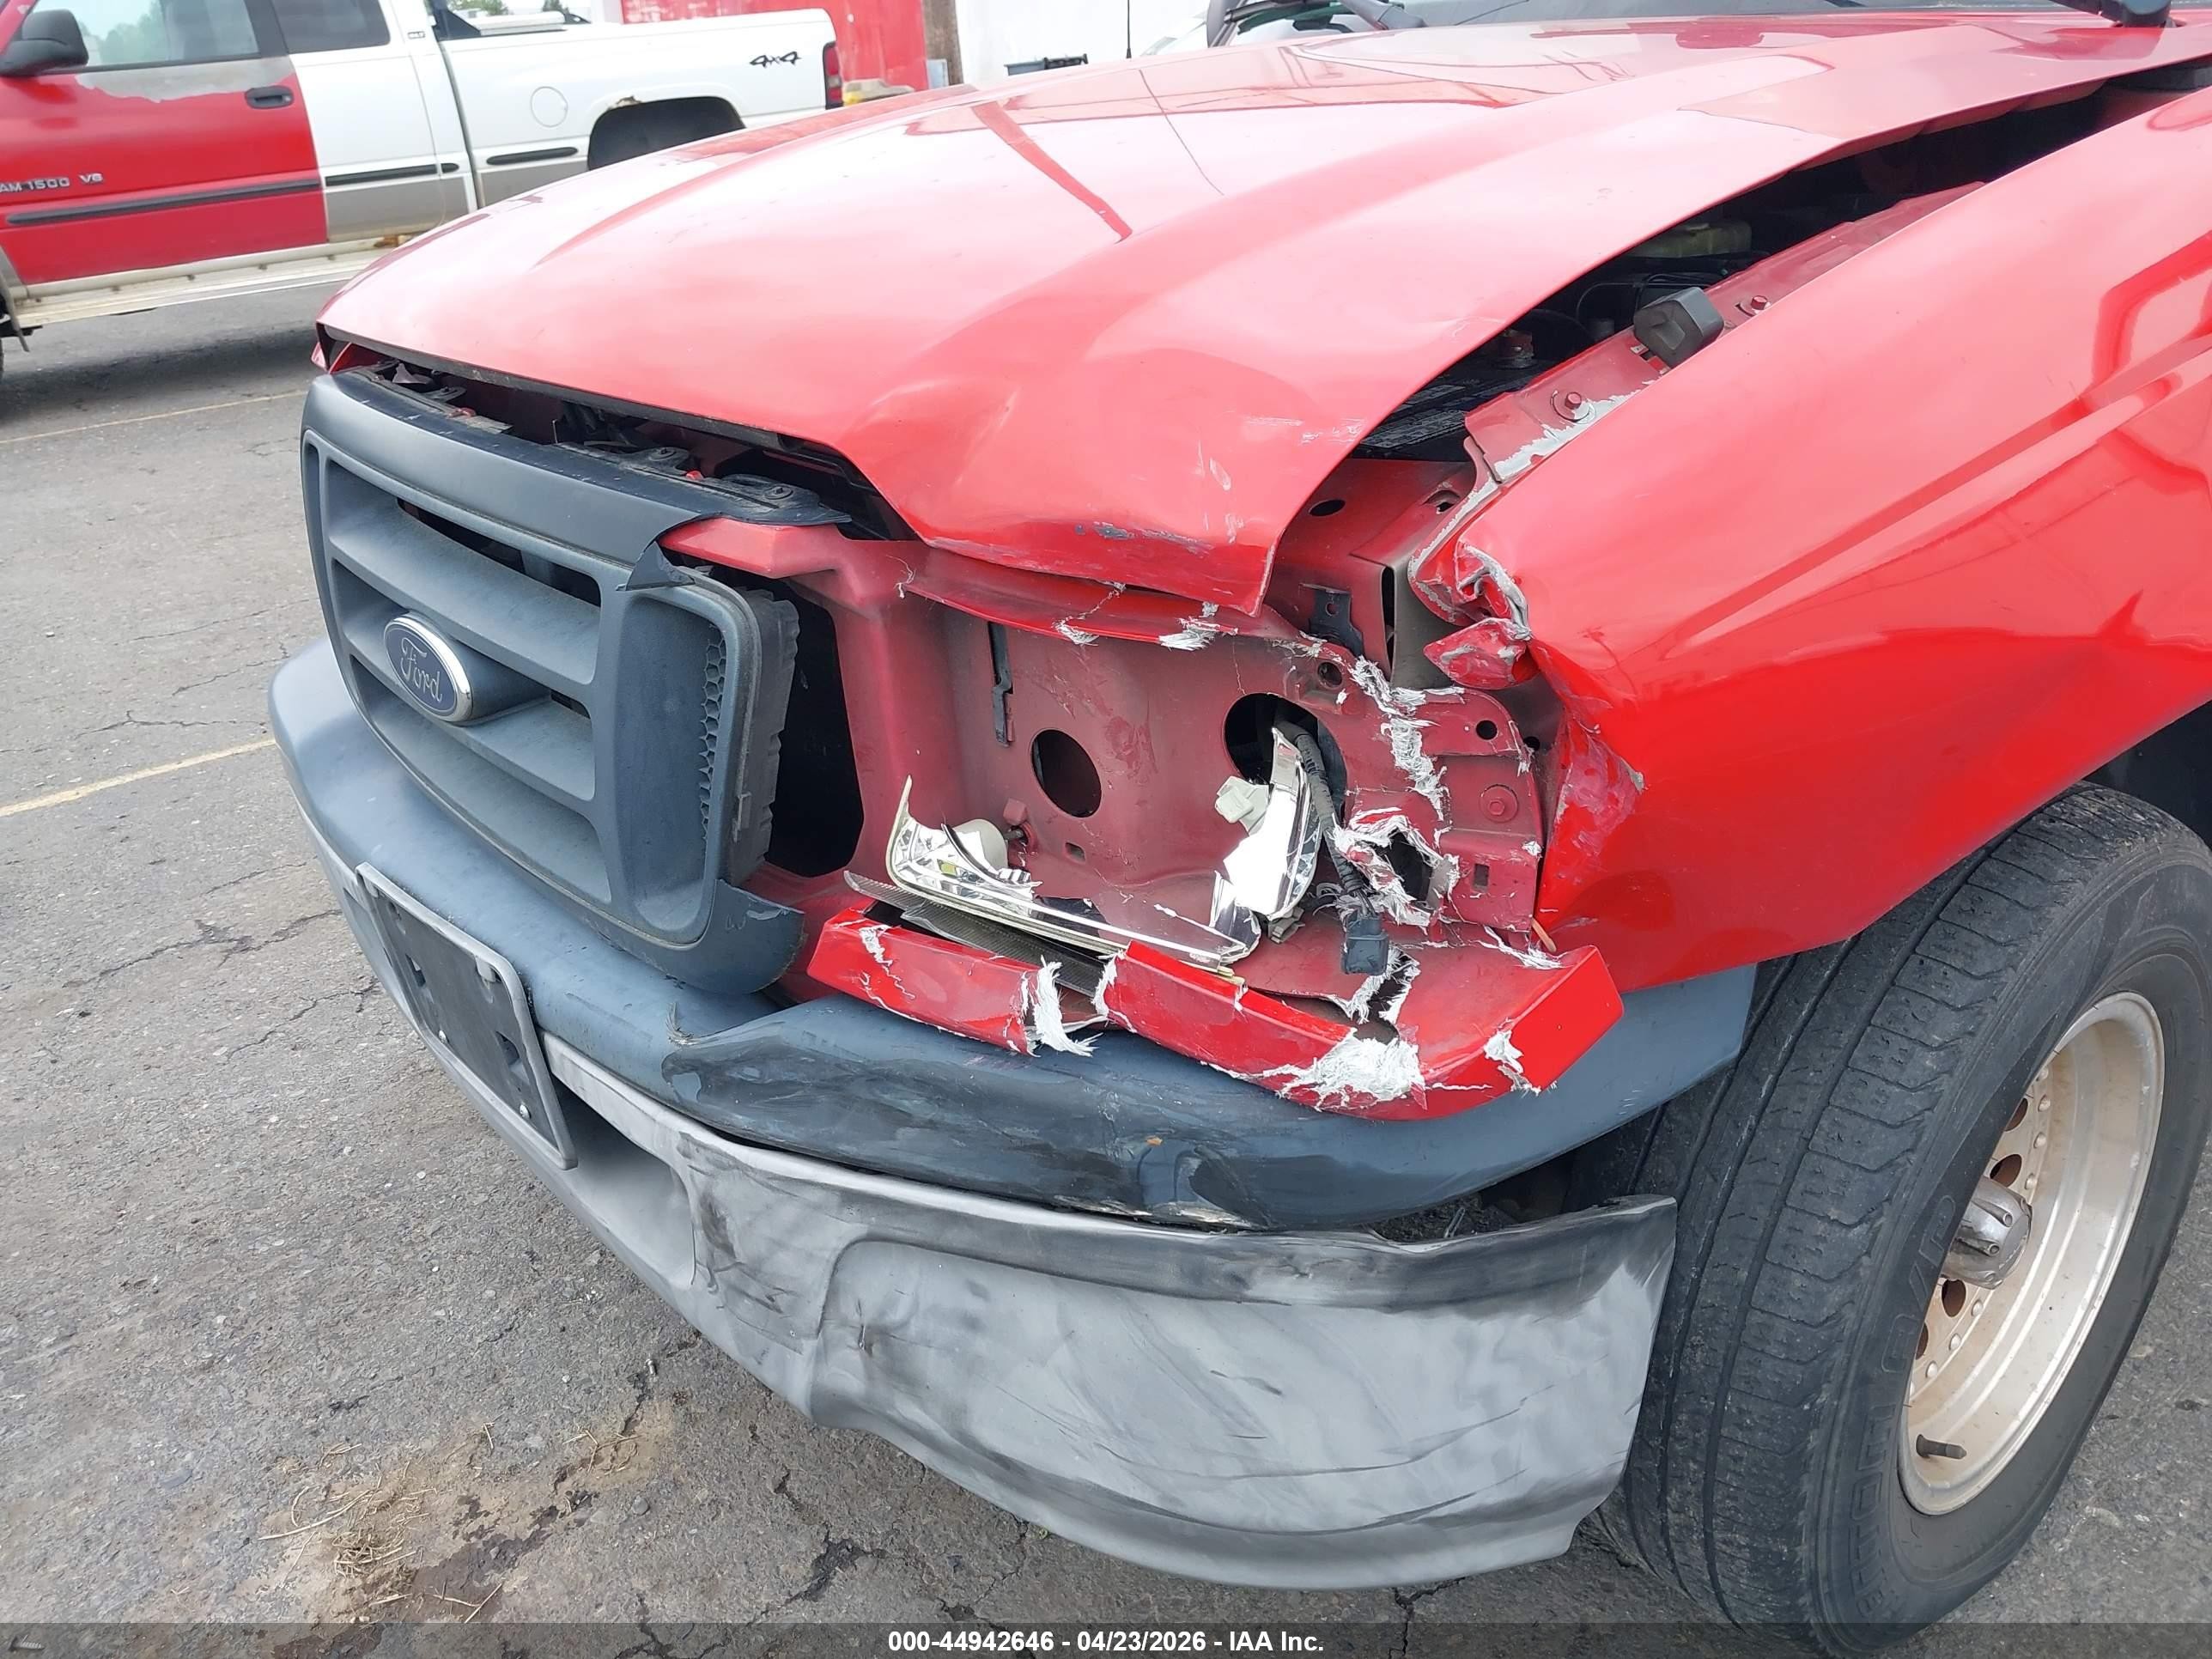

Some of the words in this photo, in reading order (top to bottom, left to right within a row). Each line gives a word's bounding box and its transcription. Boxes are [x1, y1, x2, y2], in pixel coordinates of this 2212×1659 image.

[0, 182, 22, 193] AM
[27, 177, 70, 191] 1500
[400, 636, 443, 702] Ford
